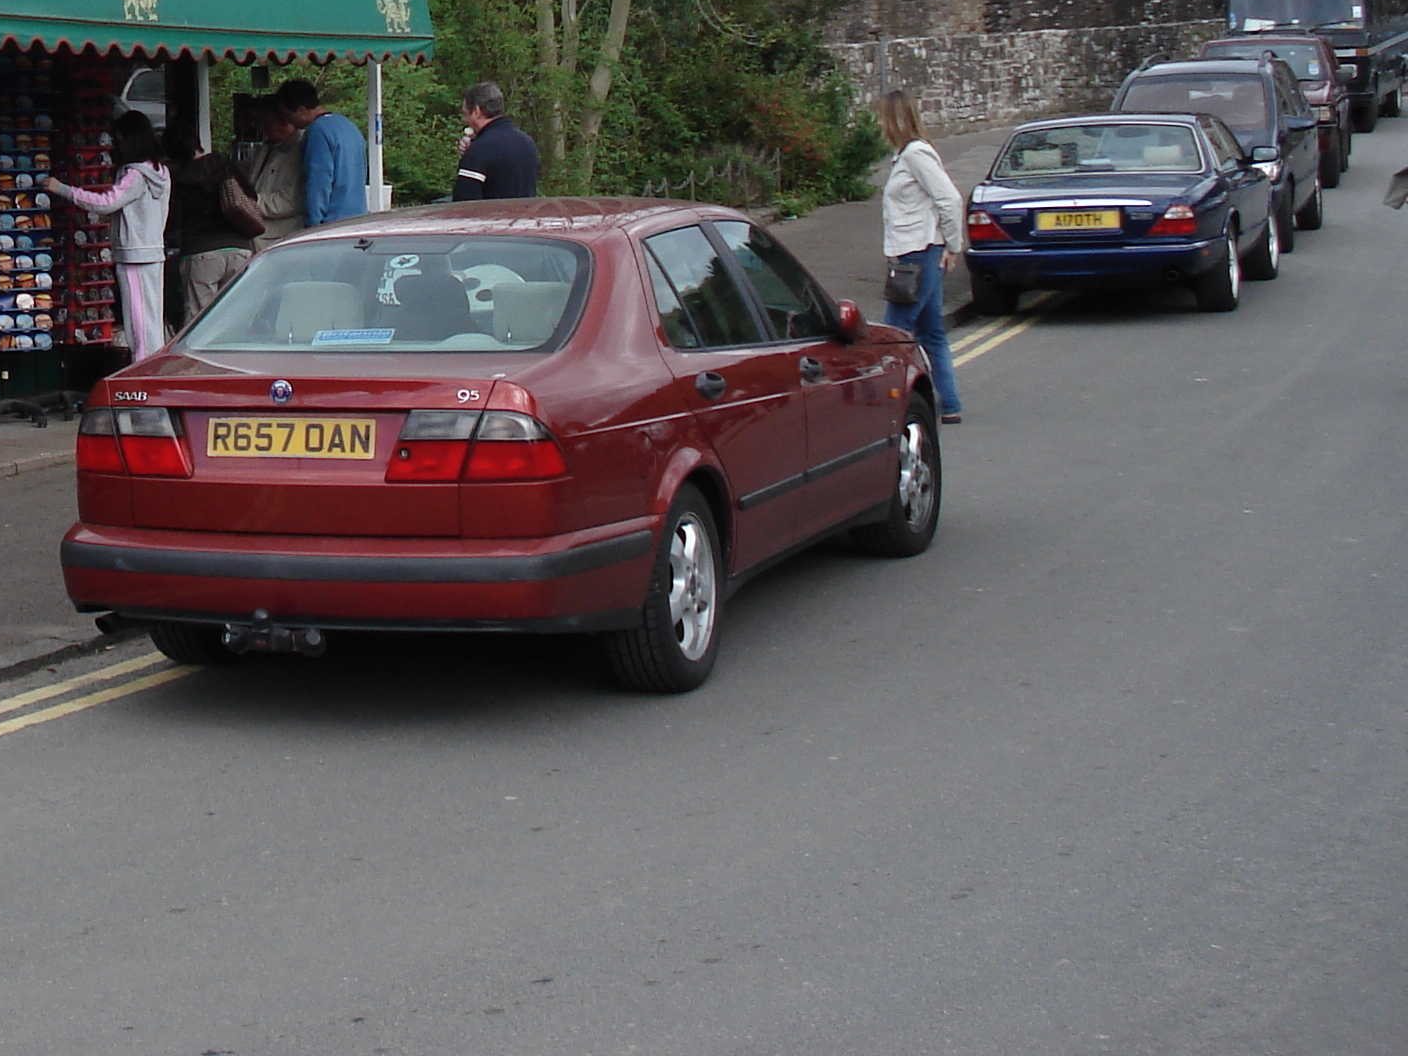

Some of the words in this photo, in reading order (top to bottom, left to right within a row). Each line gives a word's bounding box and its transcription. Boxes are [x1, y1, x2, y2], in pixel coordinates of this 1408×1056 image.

[114, 391, 148, 401] SAAB
[212, 422, 295, 452] R657
[304, 423, 370, 453] OAN
